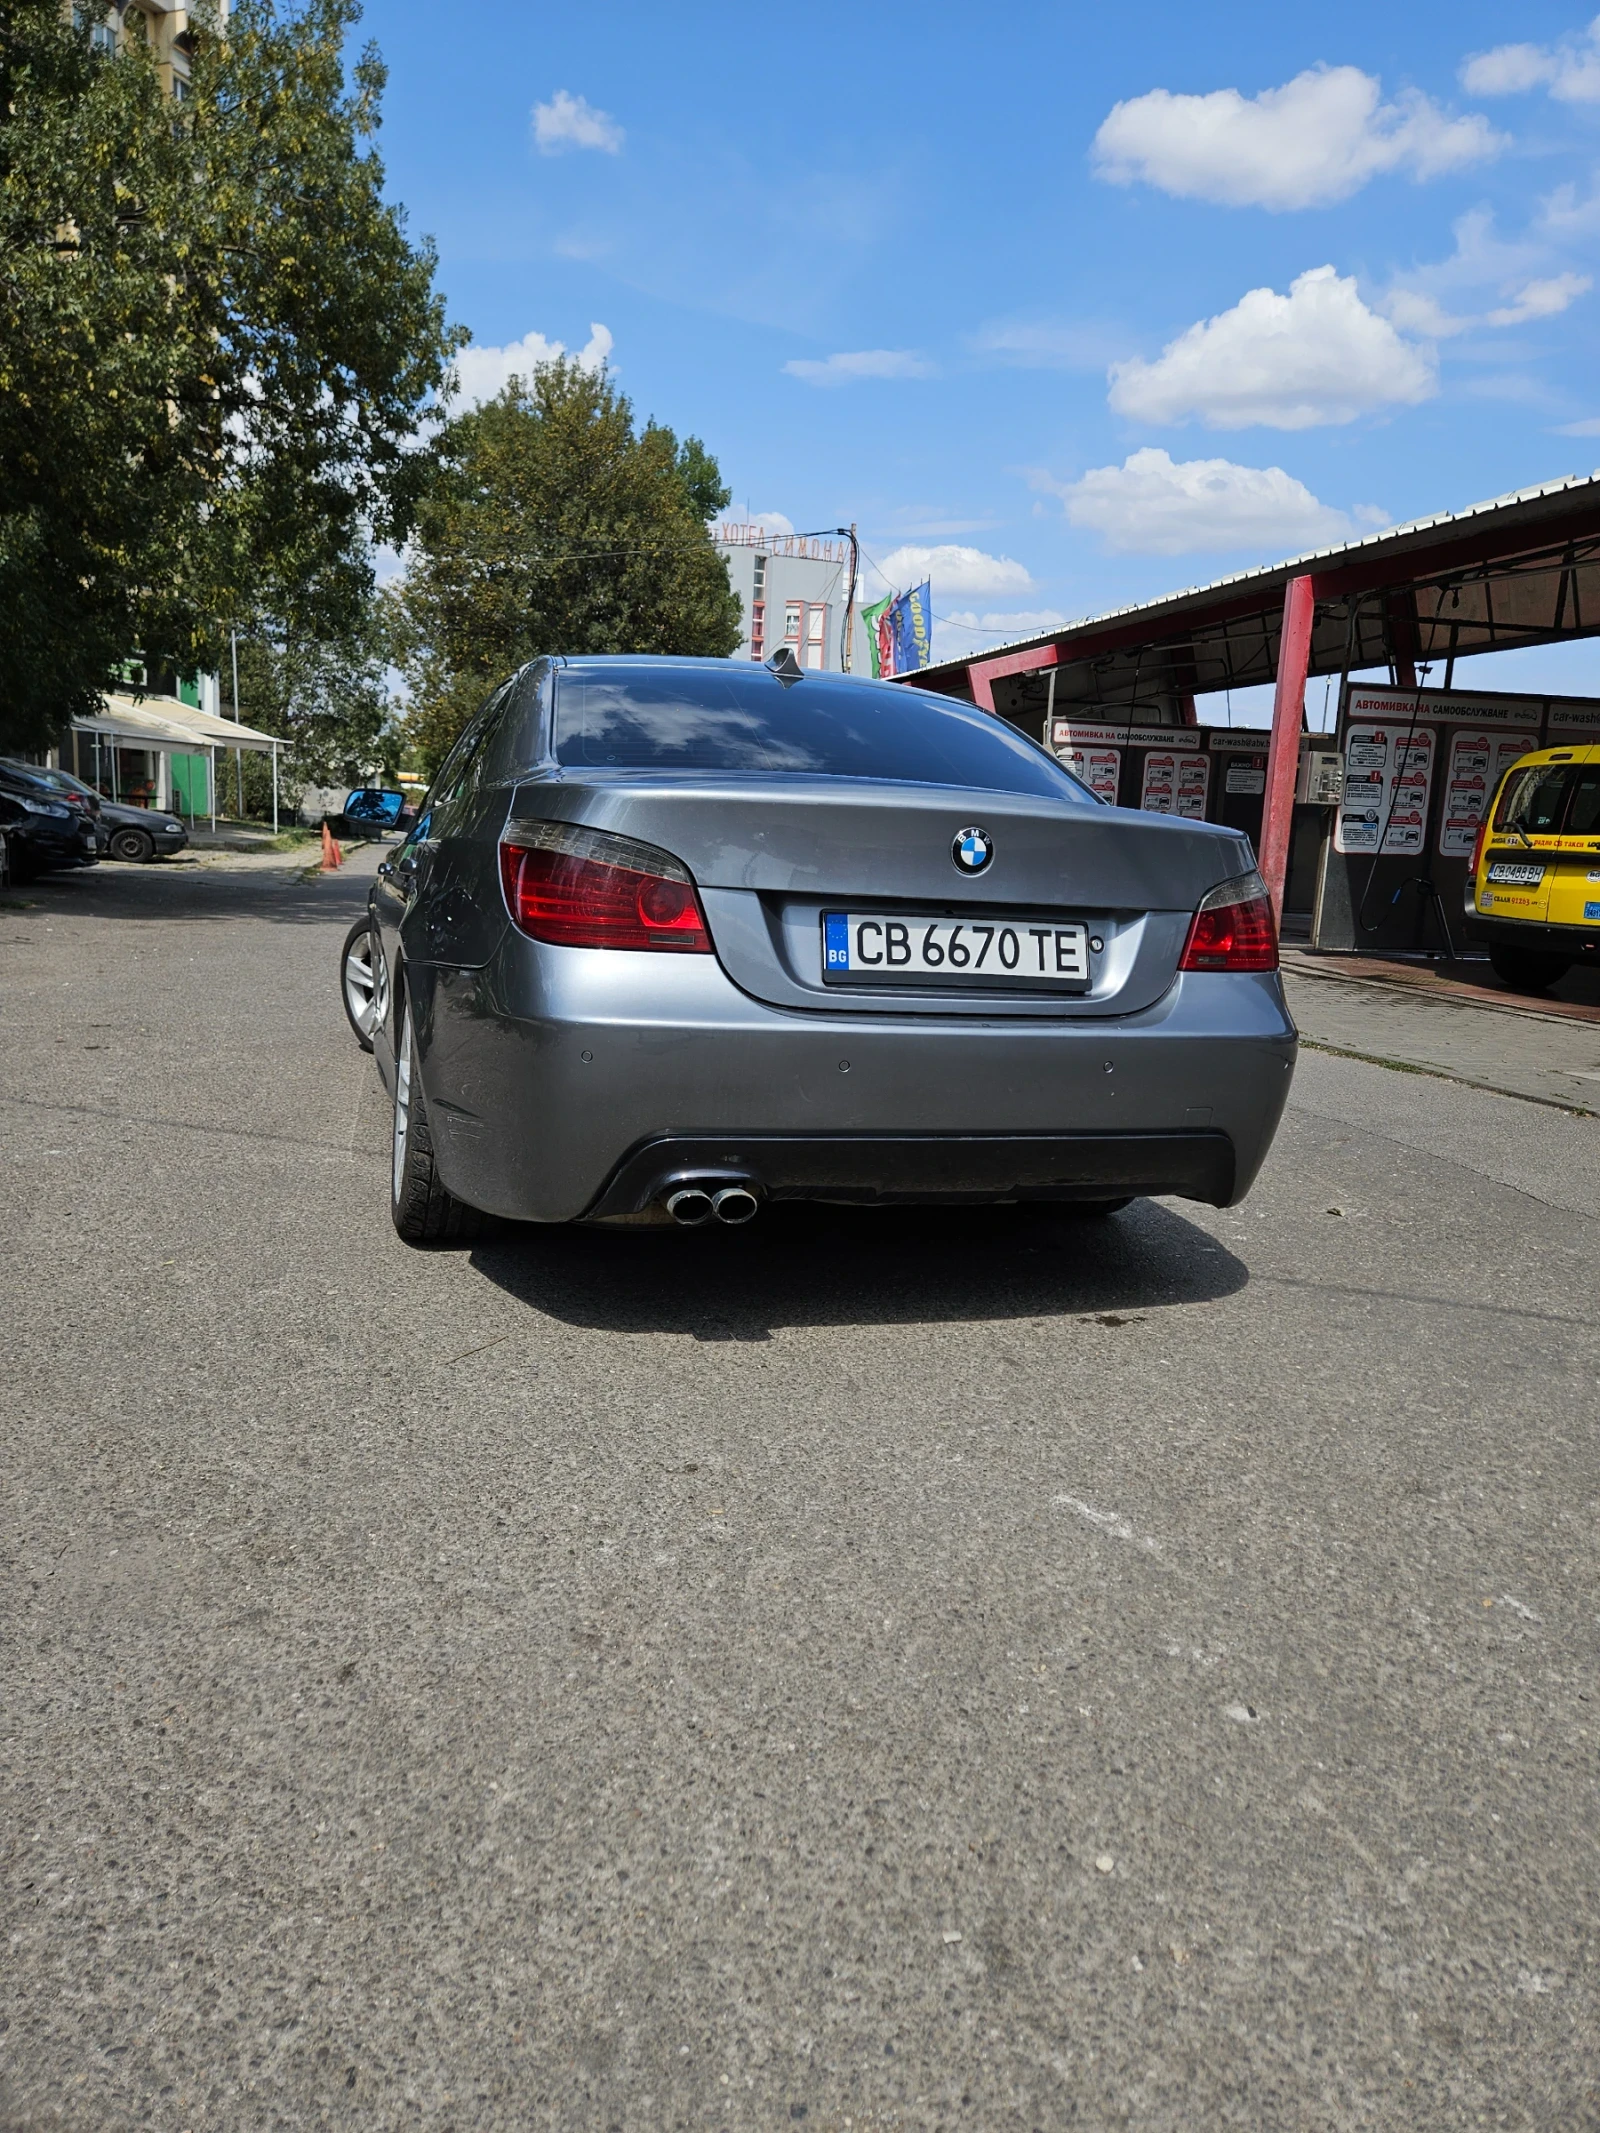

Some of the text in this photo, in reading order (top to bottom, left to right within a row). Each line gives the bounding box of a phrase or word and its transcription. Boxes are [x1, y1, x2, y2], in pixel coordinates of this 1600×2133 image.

[722, 522, 765, 550] ХОТЕЛ
[772, 533, 844, 562] СИМОНА
[1355, 699, 1508, 719] АВТОМИВКА НА САМООБСЛУЖВАНЕ
[1059, 729, 1104, 739] АВТОМИВКА
[1117, 733, 1175, 743] САМООБСЛУЖВАНЕ
[1213, 737, 1270, 748] car-wash@abv.b
[857, 921, 1080, 973] CB 6670 TE
[829, 949, 847, 963] BG
